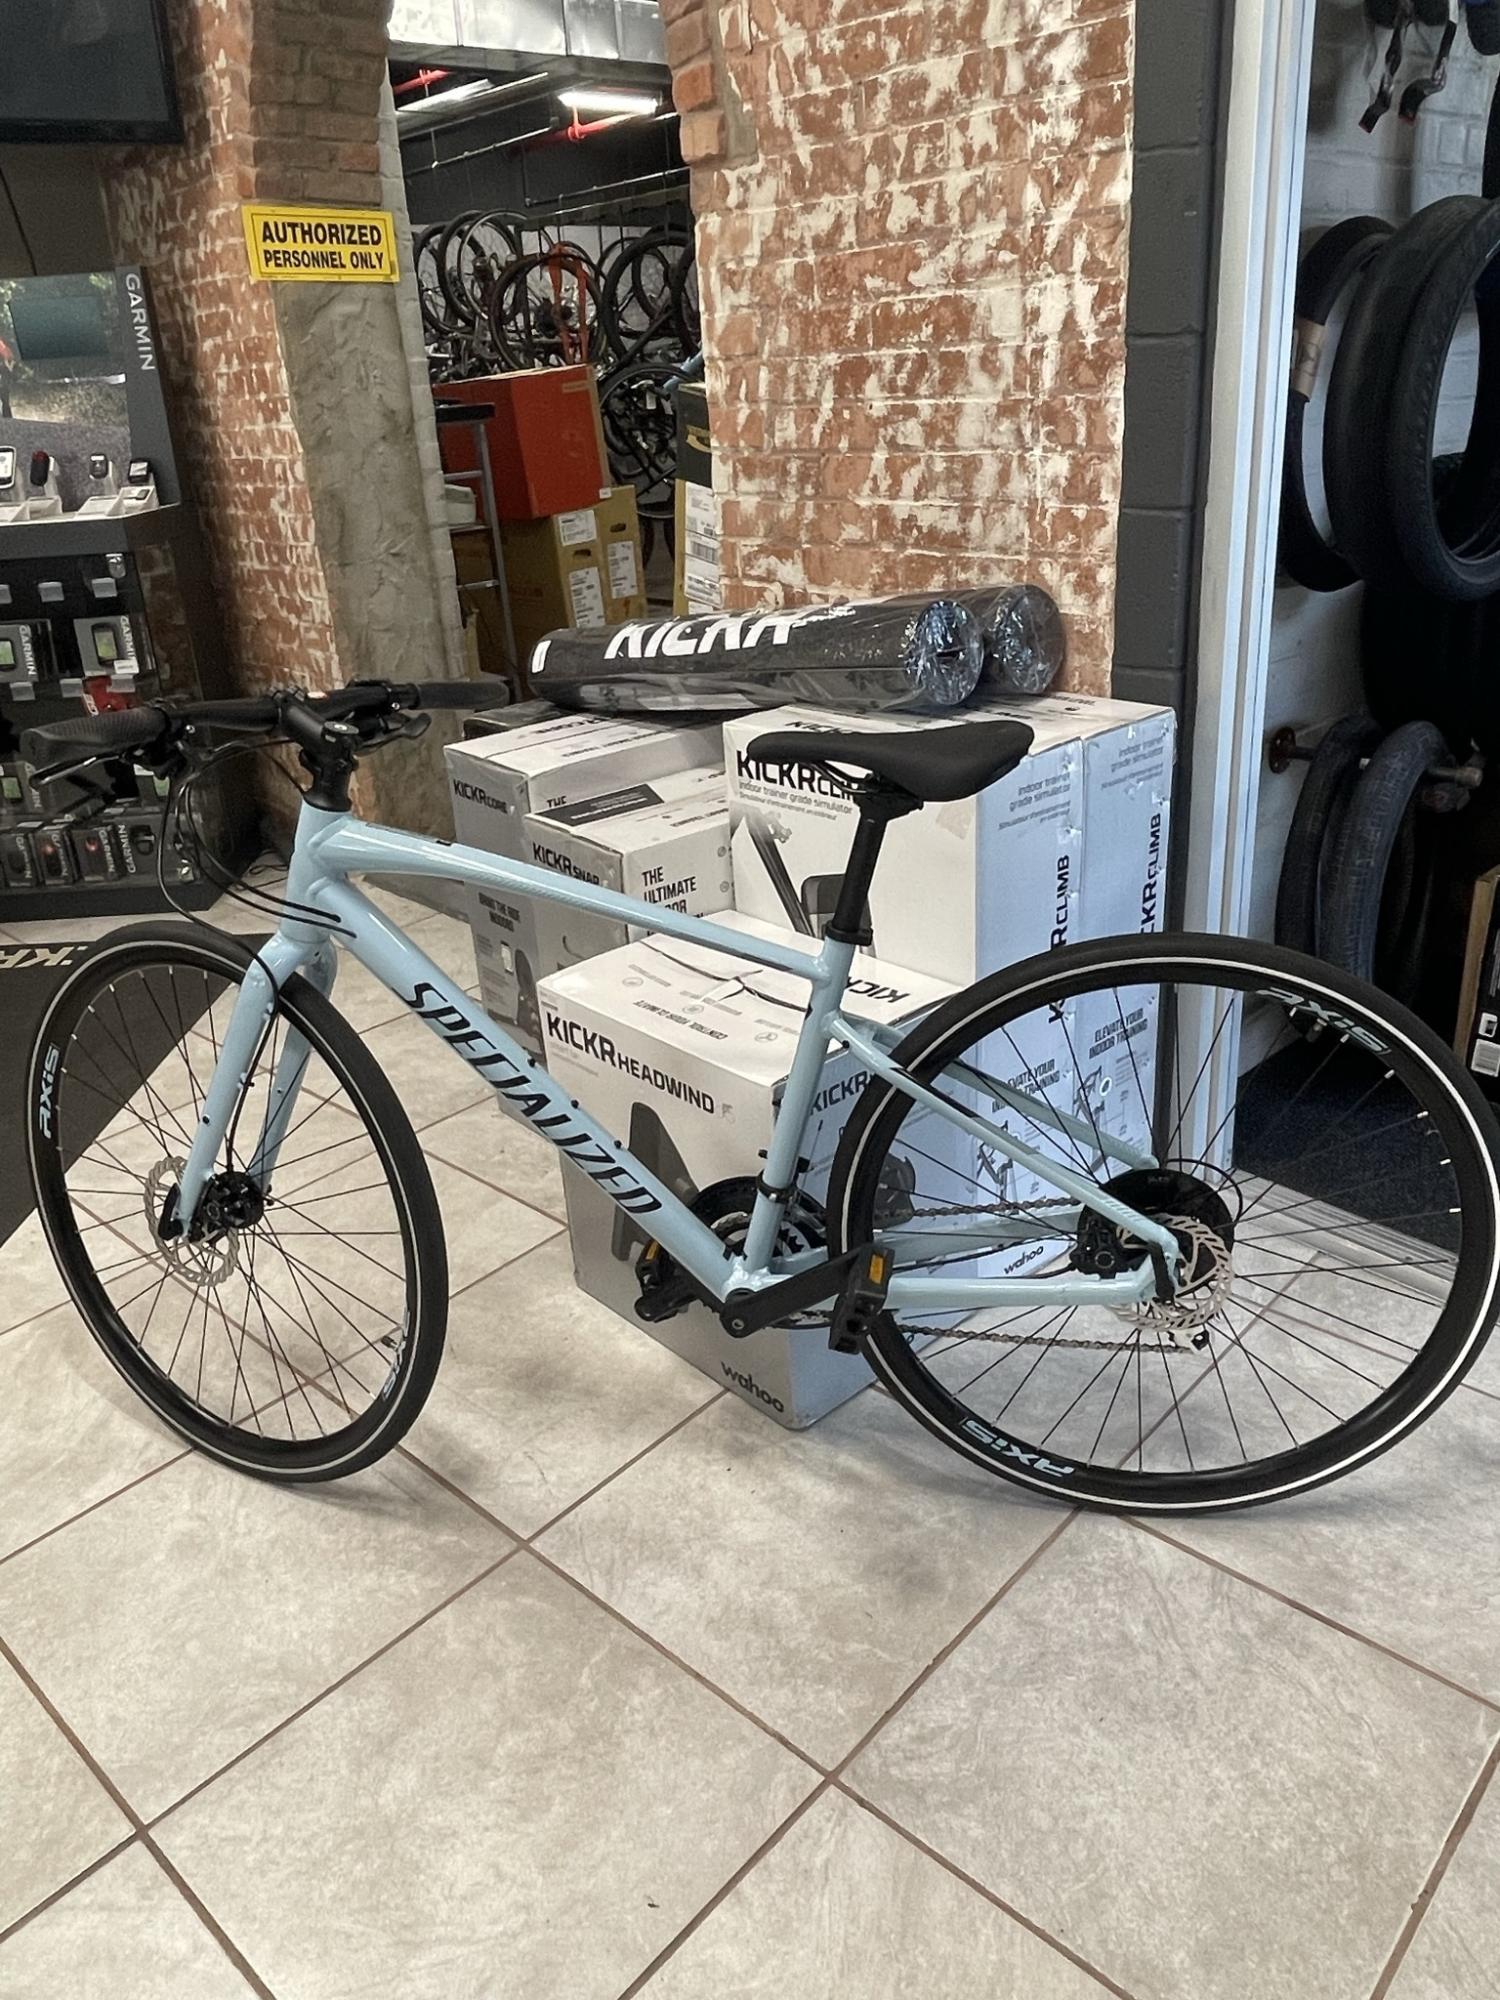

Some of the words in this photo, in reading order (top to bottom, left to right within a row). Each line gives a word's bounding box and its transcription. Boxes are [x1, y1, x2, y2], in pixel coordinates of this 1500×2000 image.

[262, 221, 382, 246] AUTHORIZED
[263, 249, 346, 269] PERSONNEL
[350, 251, 383, 269] ONLY
[126, 273, 155, 370] GARMIN
[19, 624, 37, 676] GARMIN
[118, 825, 136, 873] GARMIN
[642, 866, 664, 887] THE
[643, 876, 697, 904] ULTIMATE
[847, 976, 910, 1003] KICK
[1125, 1008, 1144, 1026] YOUR
[1034, 1058, 1056, 1079] YOUR
[408, 983, 662, 1214] SPECIALIZED
[1003, 1245, 1044, 1275] wahoo
[721, 1361, 784, 1413] wahoo
